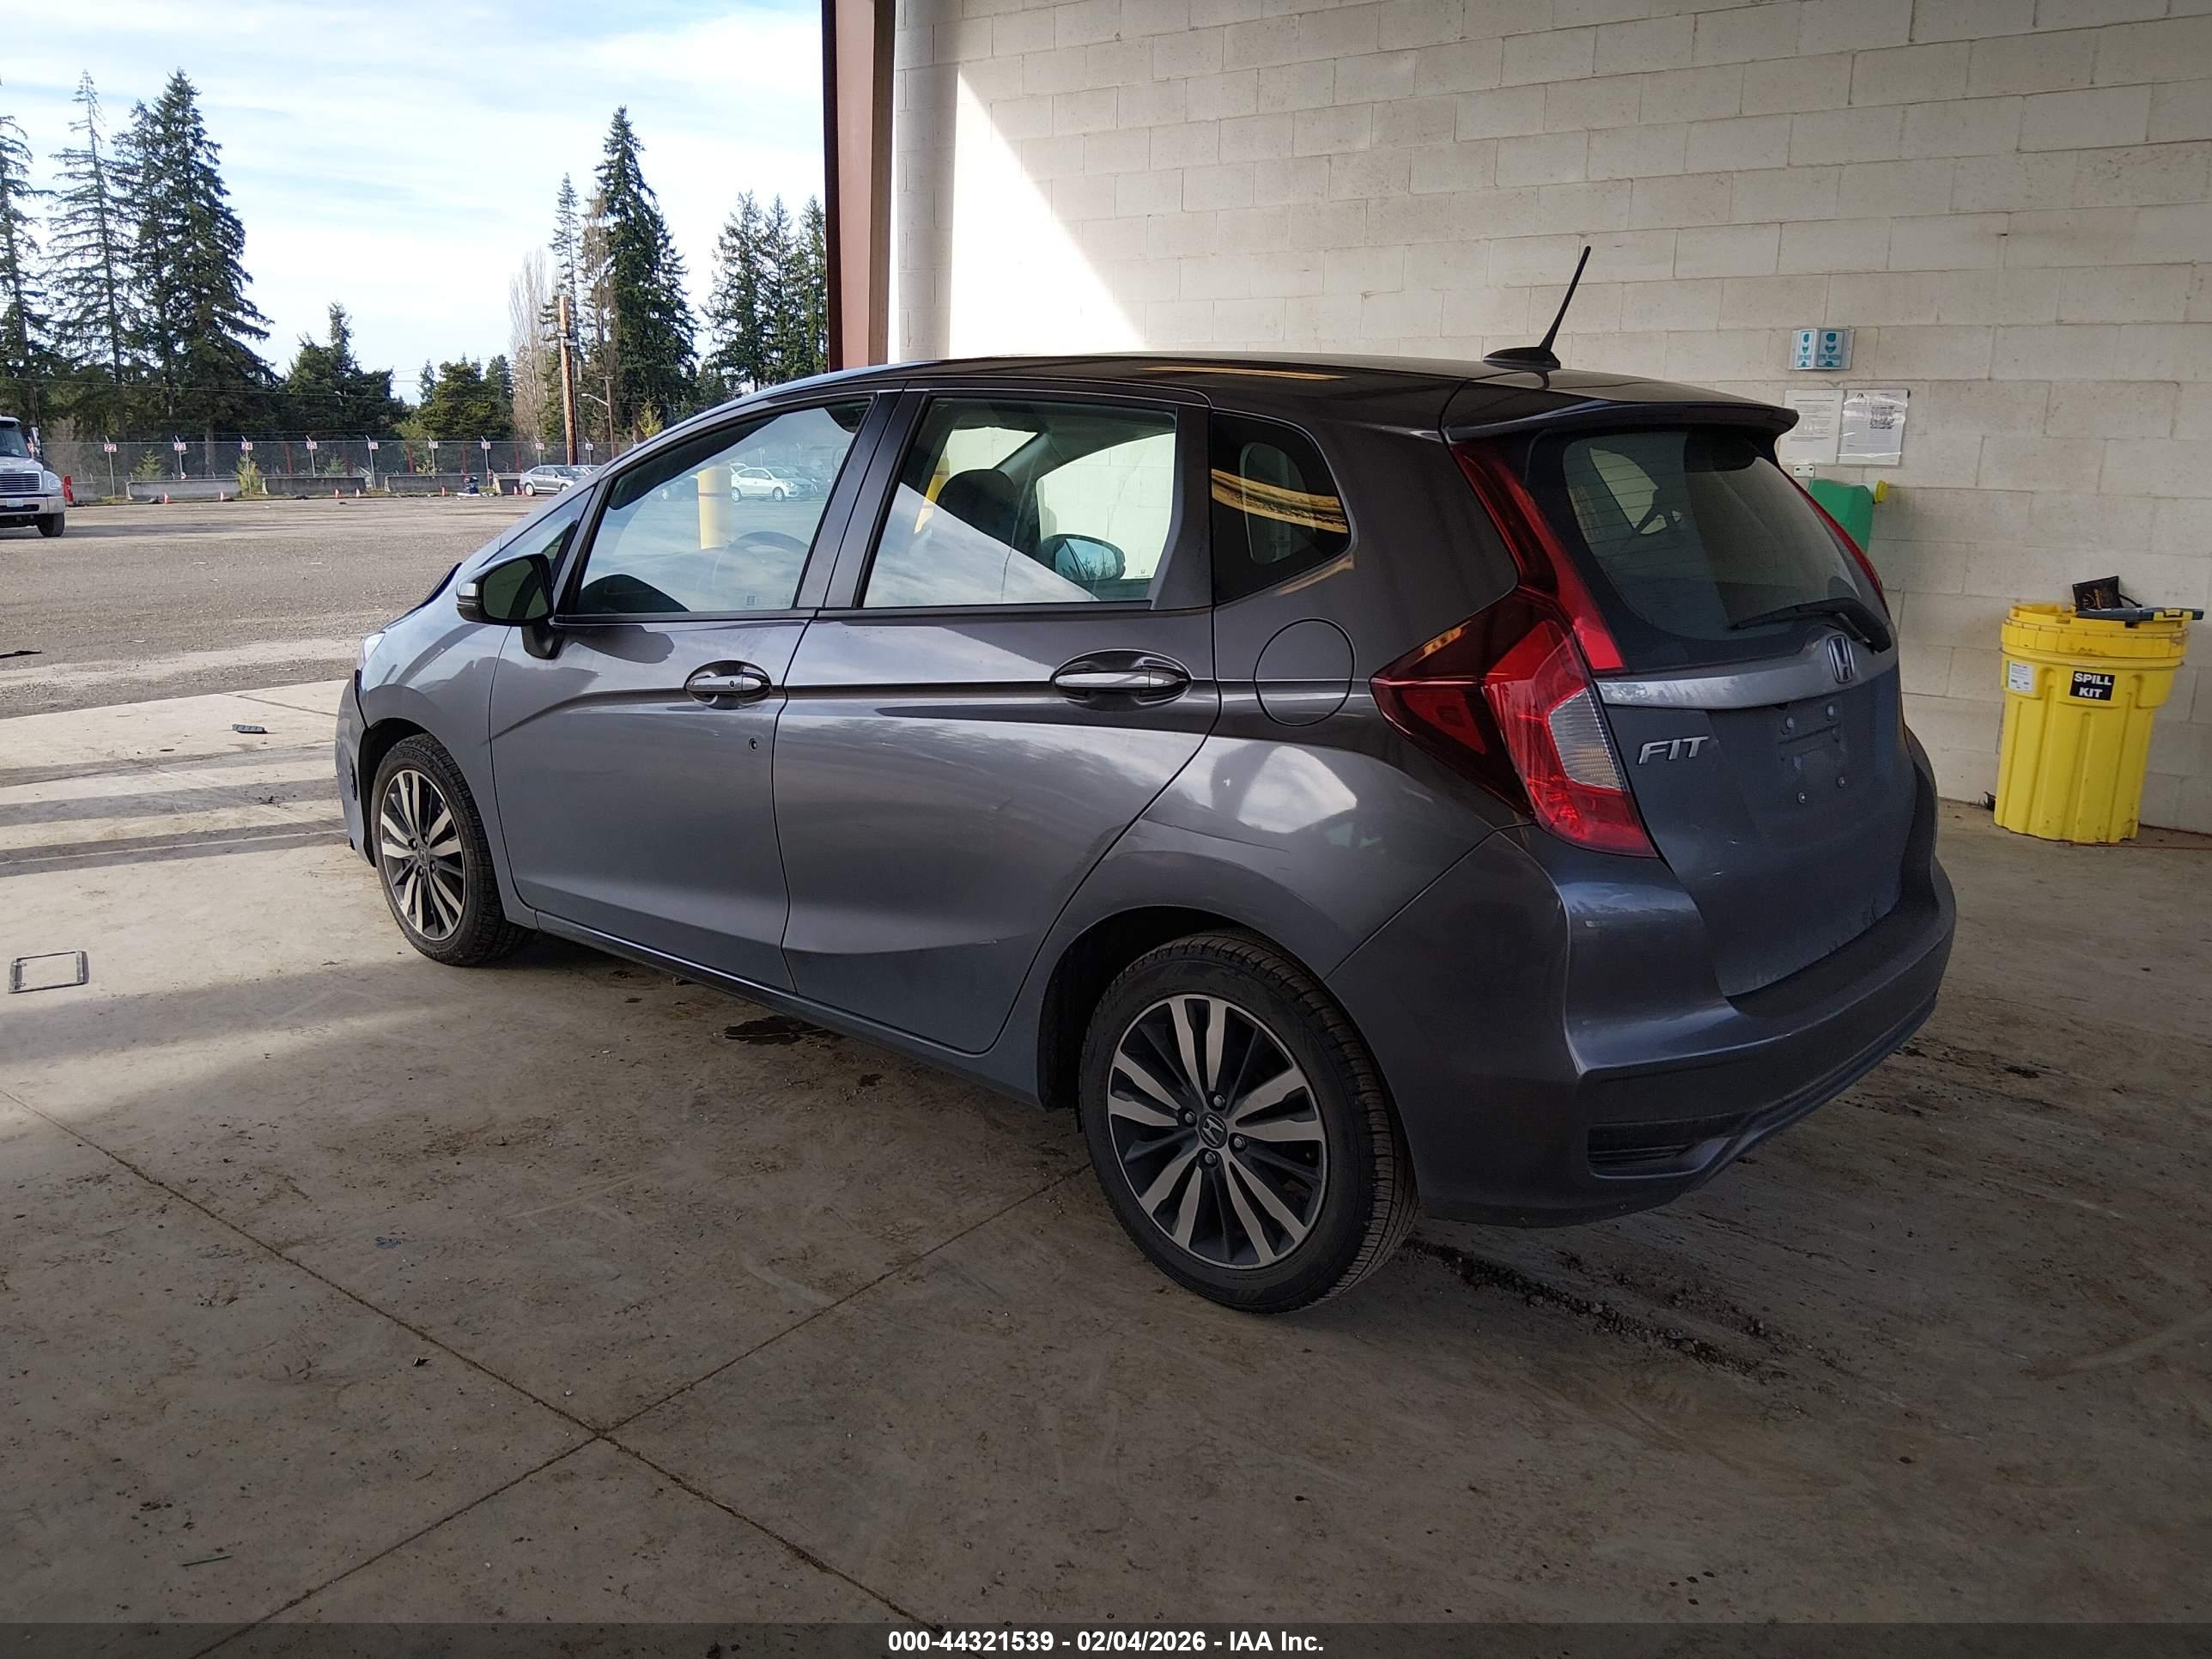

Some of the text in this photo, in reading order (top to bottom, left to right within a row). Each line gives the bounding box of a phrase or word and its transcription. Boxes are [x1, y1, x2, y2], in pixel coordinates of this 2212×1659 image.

[2074, 672, 2112, 685] SPILL
[2078, 687, 2103, 698] KIT
[1638, 735, 1710, 765] FIT
